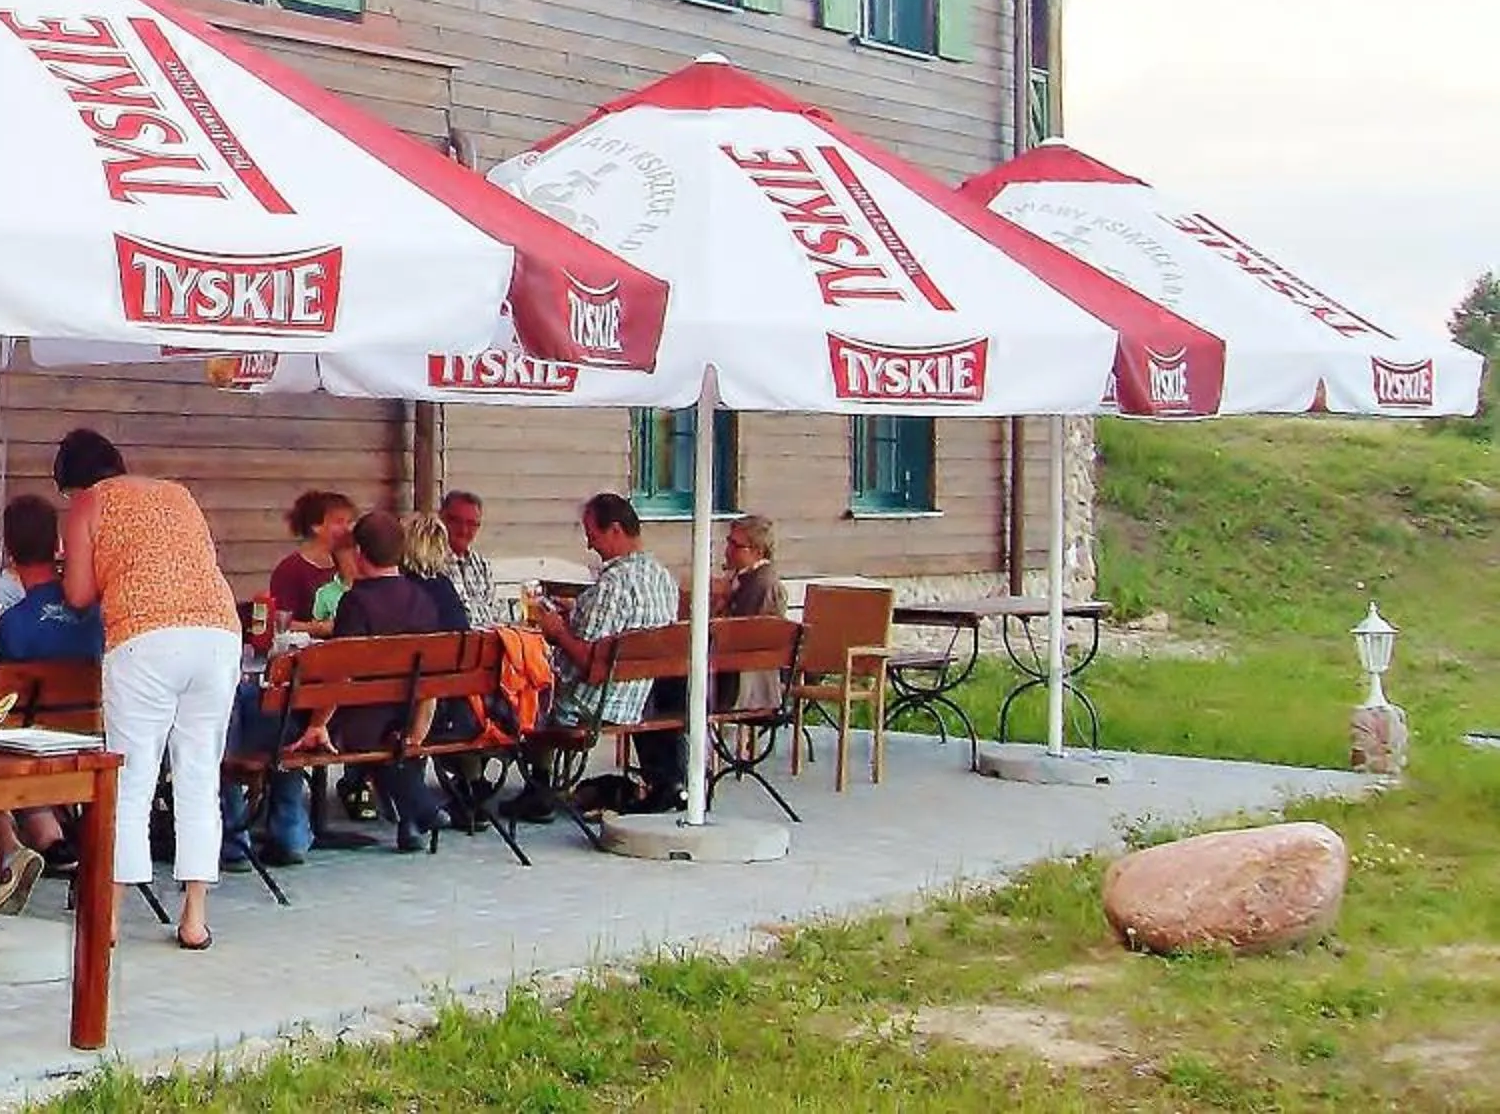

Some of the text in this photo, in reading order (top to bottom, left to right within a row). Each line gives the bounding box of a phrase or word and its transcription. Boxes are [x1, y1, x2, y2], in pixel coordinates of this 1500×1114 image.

[718, 144, 906, 306] TYSKIE
[131, 252, 326, 324] TYSKIE
[567, 288, 624, 353] TYSKIE
[840, 347, 977, 395] TYSKIE
[1148, 359, 1189, 403] TYSKIE
[1375, 365, 1431, 401] TYSKIE
